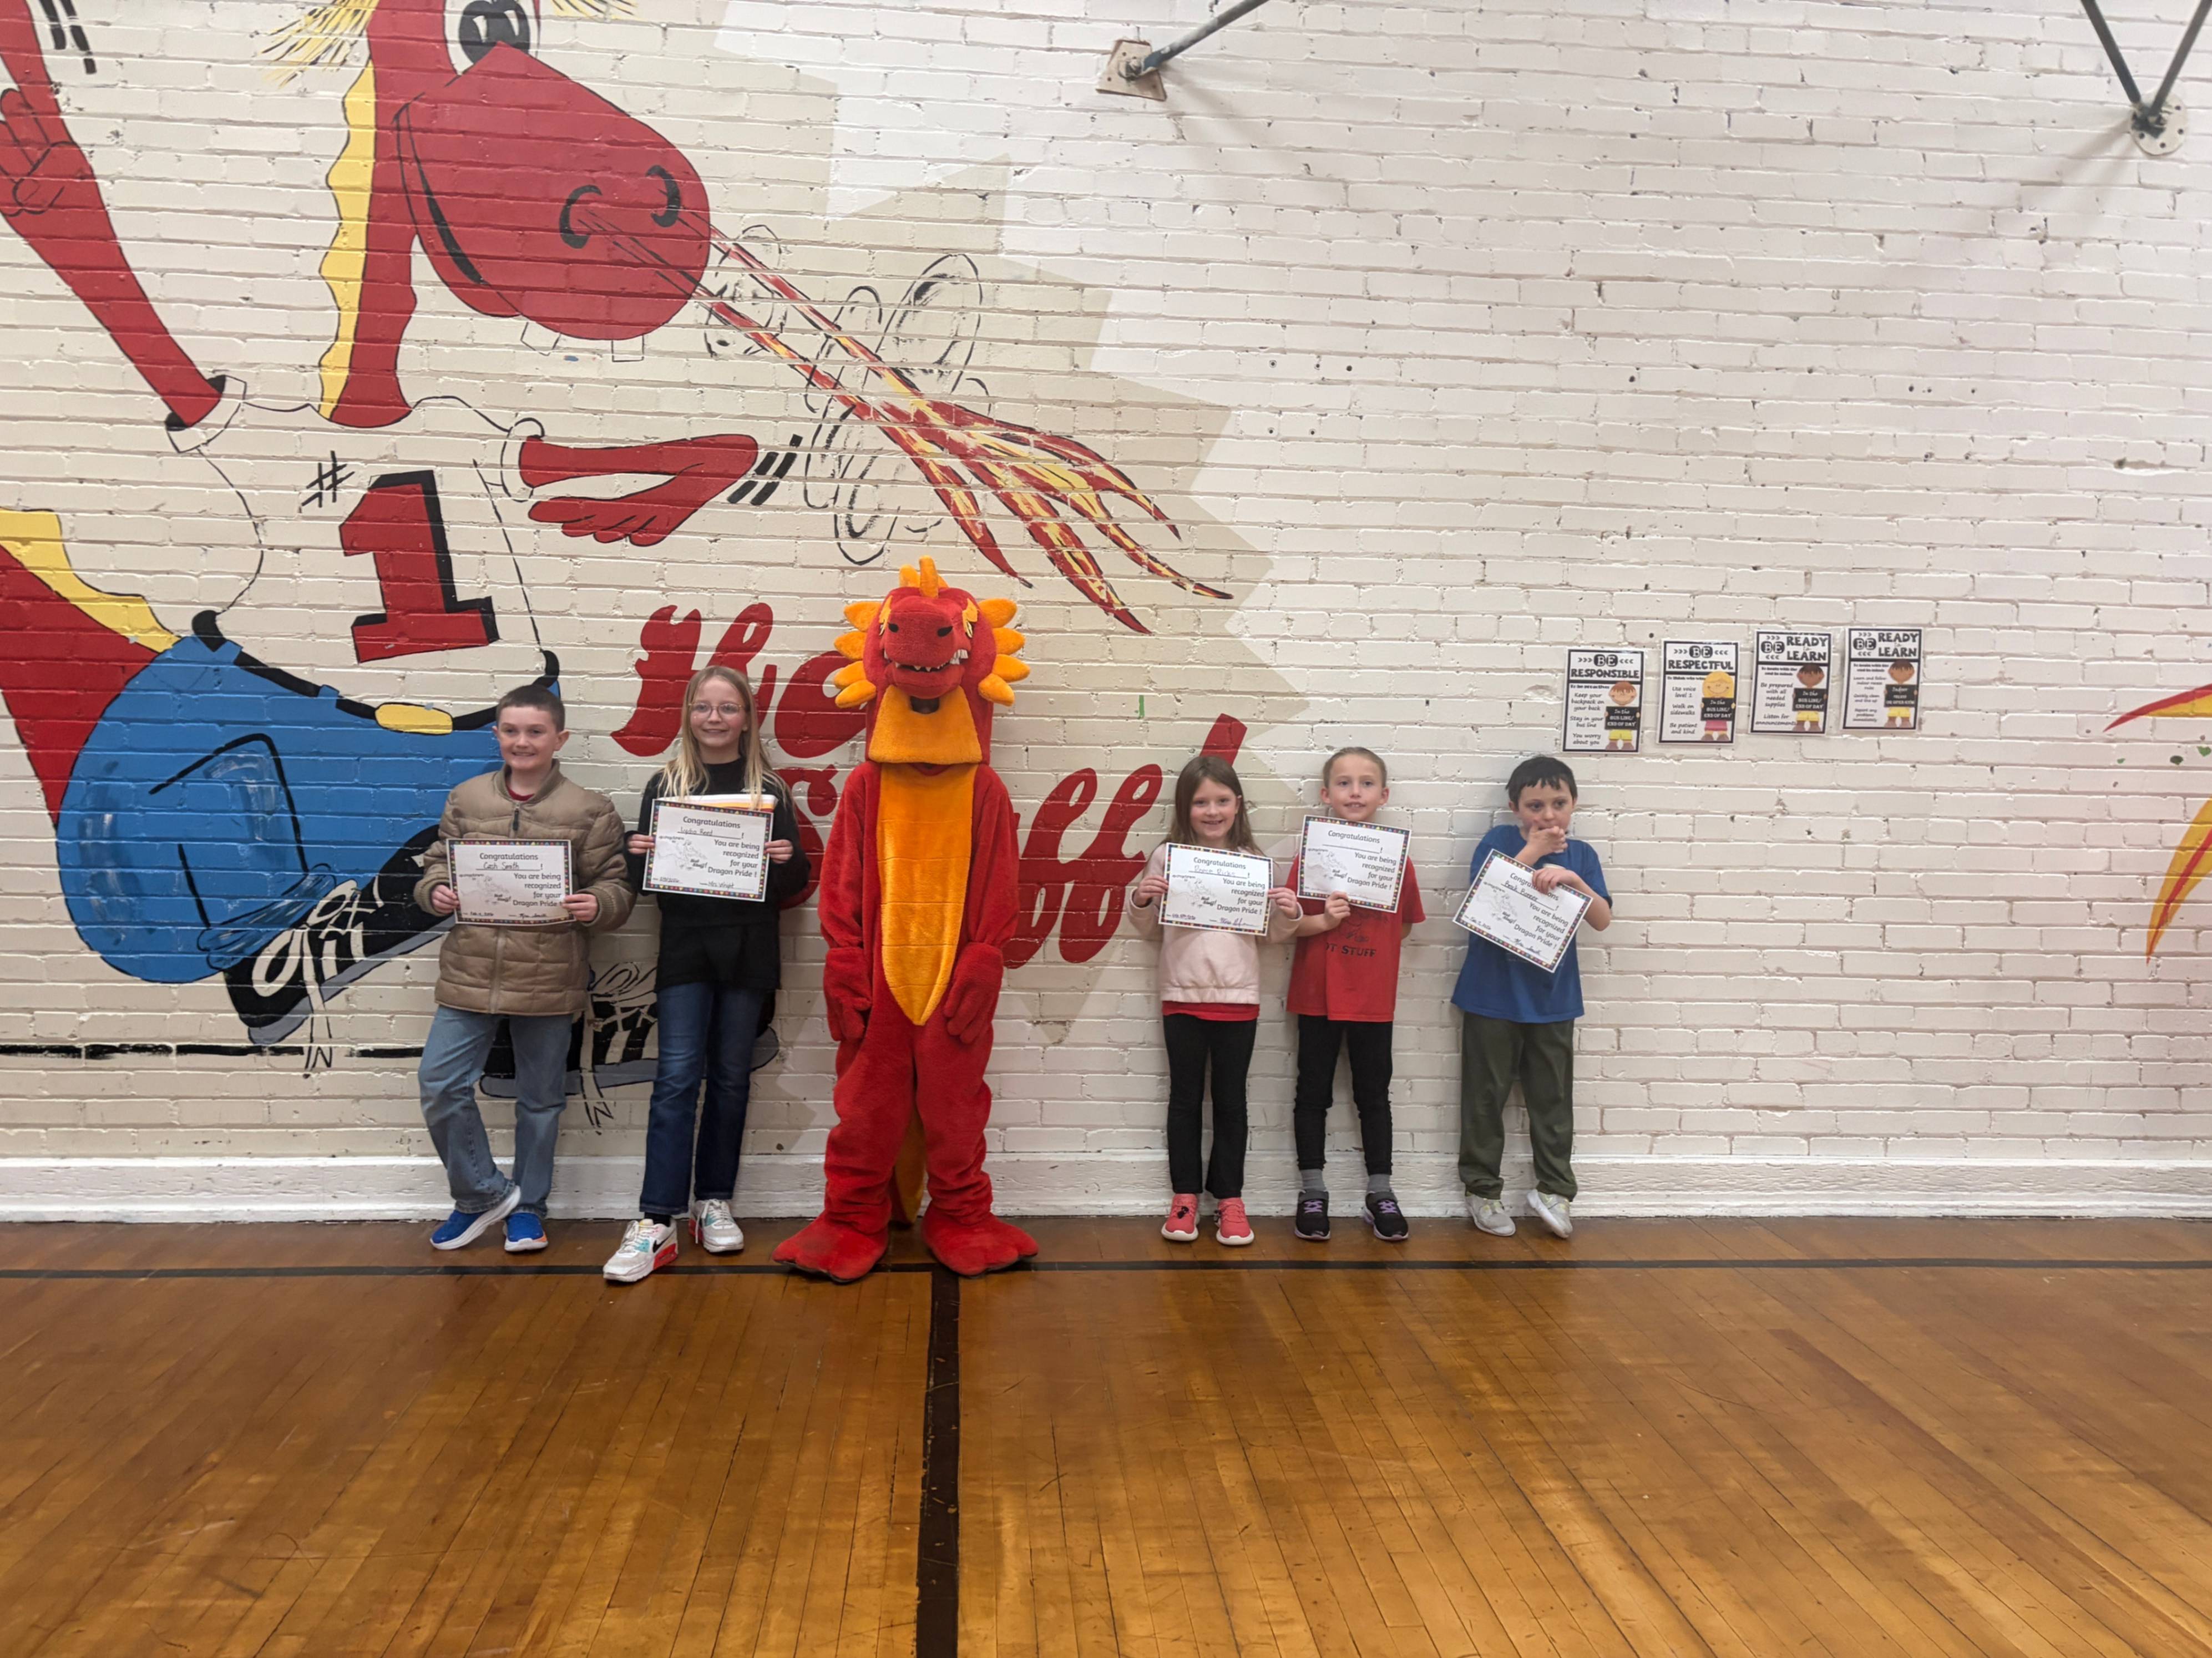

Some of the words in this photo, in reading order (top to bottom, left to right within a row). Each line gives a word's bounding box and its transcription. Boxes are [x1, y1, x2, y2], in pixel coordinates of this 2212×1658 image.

[302, 450, 499, 663] #1
[1786, 636, 1828, 646] READY
[1878, 633, 1919, 643] READY
[1763, 642, 1784, 653] BE
[1855, 639, 1875, 649] BE
[1691, 646, 1712, 658] BE
[1786, 651, 1826, 661] LEARN
[1878, 648, 1917, 657] LEARN
[1596, 655, 1617, 666] BE
[1668, 659, 1734, 670] RESPECTFUL
[1571, 668, 1639, 679] RESPONSIBLE
[610, 603, 868, 759] Ho
[683, 816, 741, 828] Congratulations
[1328, 830, 1380, 843] Congratulations
[741, 841, 760, 851] being
[479, 852, 538, 862] Congratulations
[723, 851, 759, 860] recognized
[1379, 855, 1396, 866] being
[1193, 857, 1246, 869] Congratulations
[1362, 863, 1395, 873] recognized
[541, 873, 561, 881] being
[708, 867, 733, 876] Dragon
[1248, 880, 1265, 889] being
[1347, 877, 1370, 887] Dragon
[1371, 881, 1388, 889] Pride
[1231, 888, 1264, 897] recognized
[1217, 904, 1240, 913] Dragon
[1528, 902, 1540, 912] You
[1552, 913, 1568, 927] being
[1533, 915, 1565, 933] recognized
[1514, 924, 1536, 939] Dragon
[1537, 935, 1553, 947] Pride
[1535, 925, 1546, 934] for
[1546, 931, 1561, 942] your
[1342, 945, 1376, 957] STUFF
